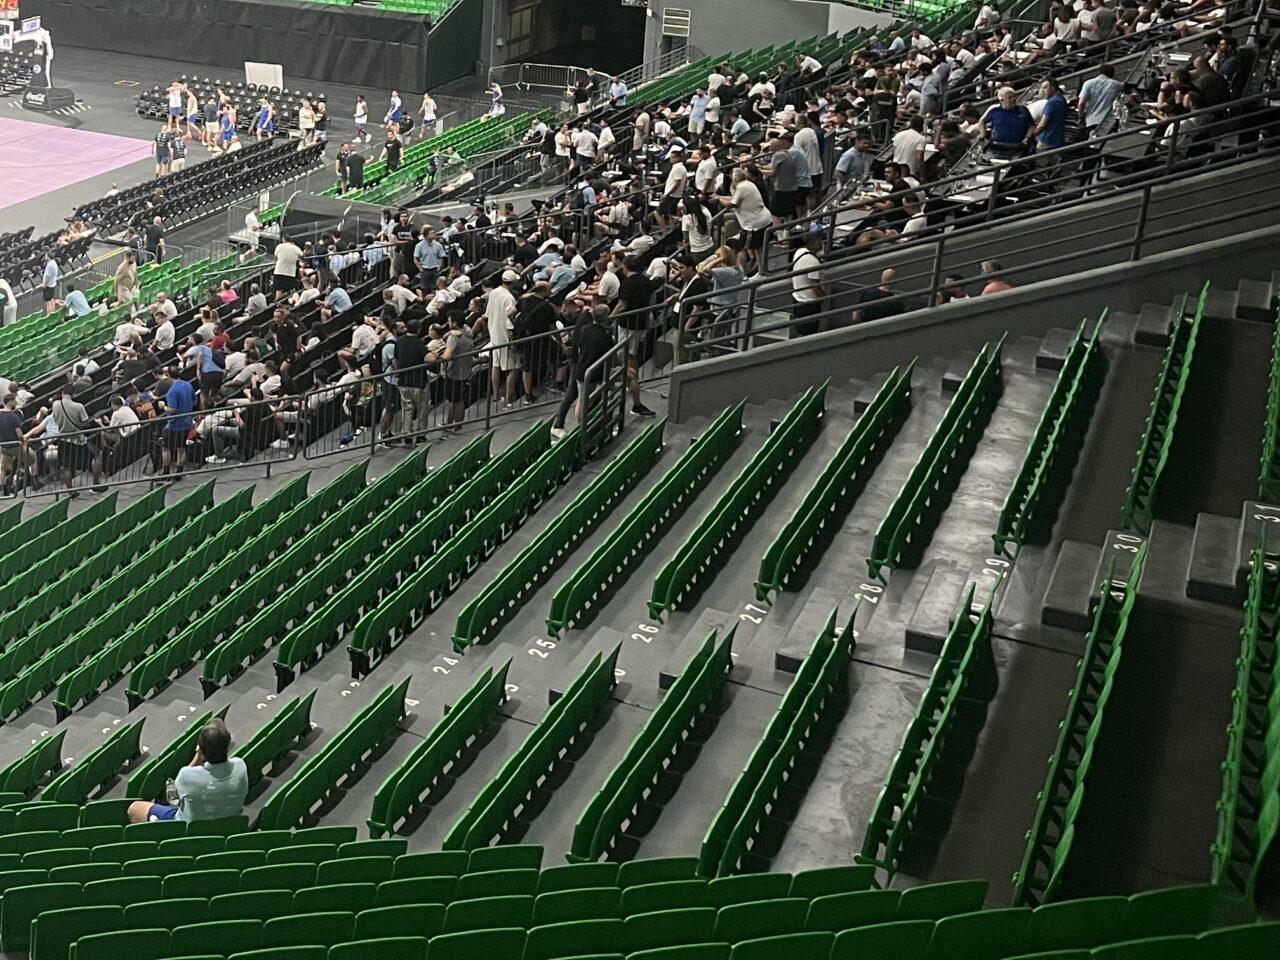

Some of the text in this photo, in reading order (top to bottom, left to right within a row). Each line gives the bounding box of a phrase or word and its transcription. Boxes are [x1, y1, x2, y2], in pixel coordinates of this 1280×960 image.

[1113, 534, 1142, 553] 30
[982, 558, 1010, 578] 29
[854, 583, 883, 604] 28
[740, 603, 768, 624] 27
[631, 623, 660, 644] 26
[528, 638, 557, 660] 25
[432, 656, 460, 675] 24
